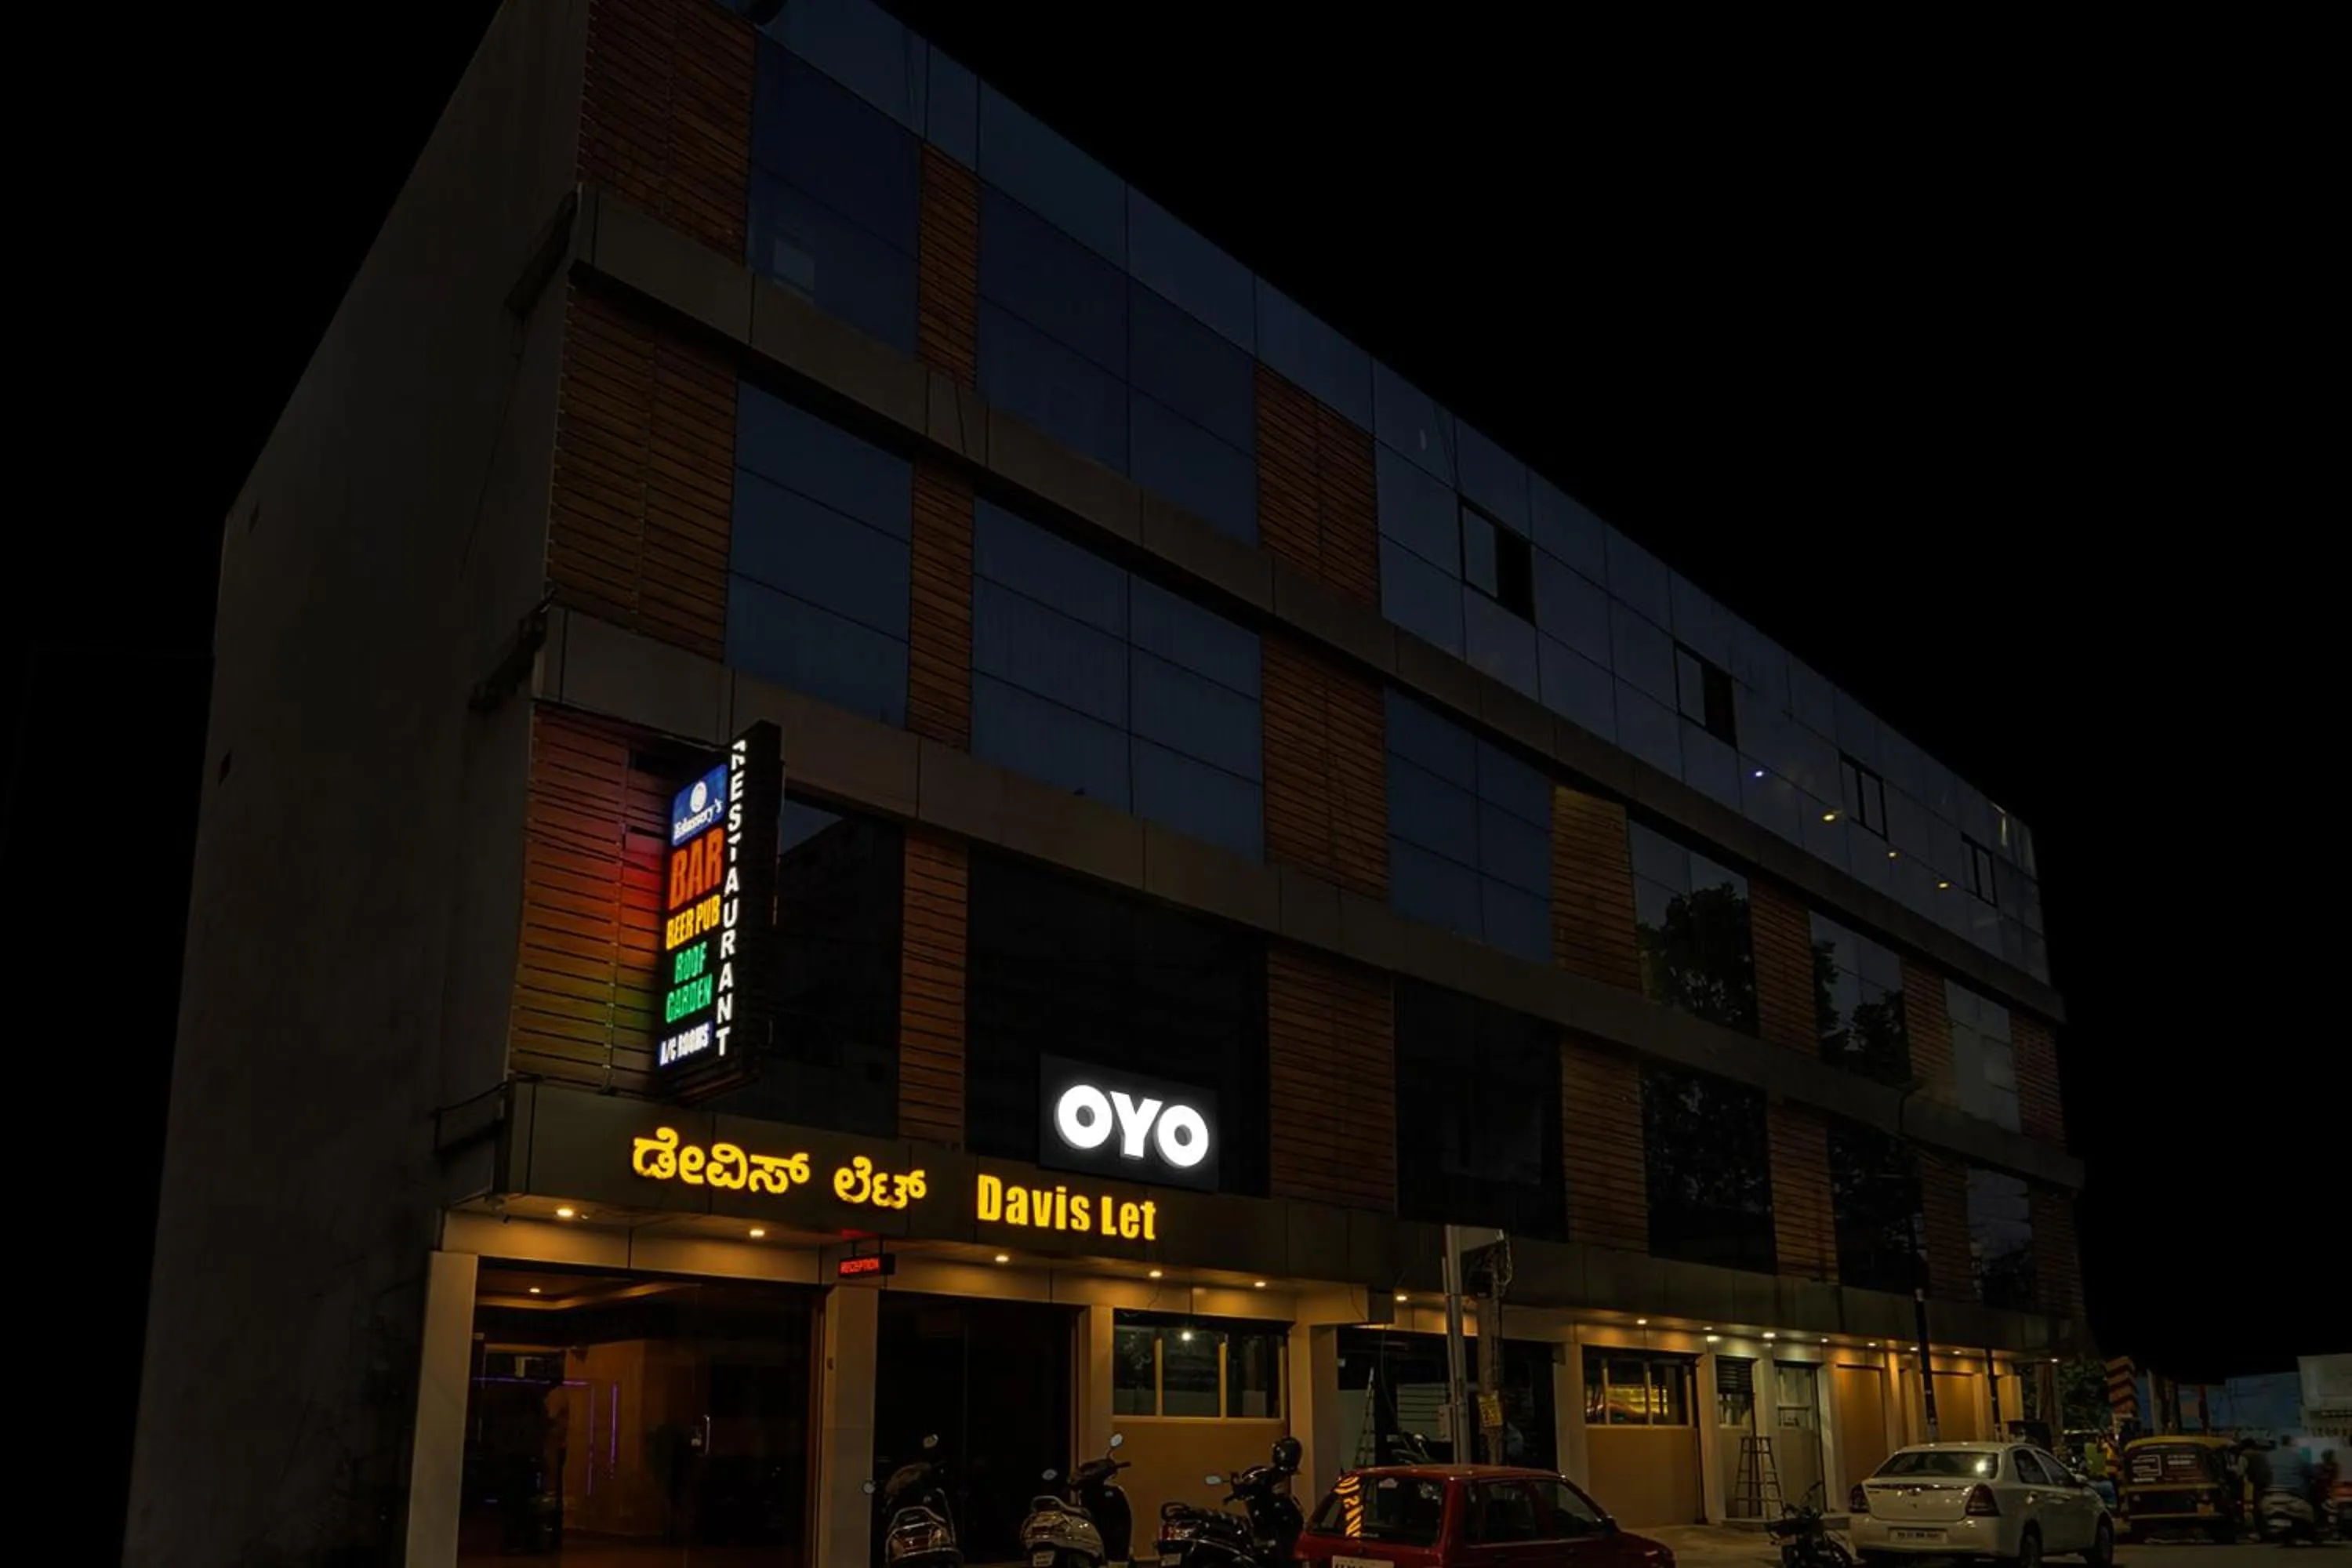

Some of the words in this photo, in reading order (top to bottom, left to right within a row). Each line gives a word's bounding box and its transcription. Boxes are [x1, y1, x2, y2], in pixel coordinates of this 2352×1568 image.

[669, 827, 724, 910] BAR
[666, 905, 695, 950] BEER
[695, 895, 720, 938] PUB
[674, 941, 707, 985] ROOF
[666, 972, 713, 1023] GARDEN
[1054, 1084, 1210, 1168] OYO
[633, 1127, 810, 1194] ಡೇವಿಸ್
[833, 1156, 927, 1209] ಲೆಟ್
[978, 1174, 1091, 1232] Davis
[1101, 1196, 1156, 1240] Let
[840, 1258, 880, 1274] RECEPTION
